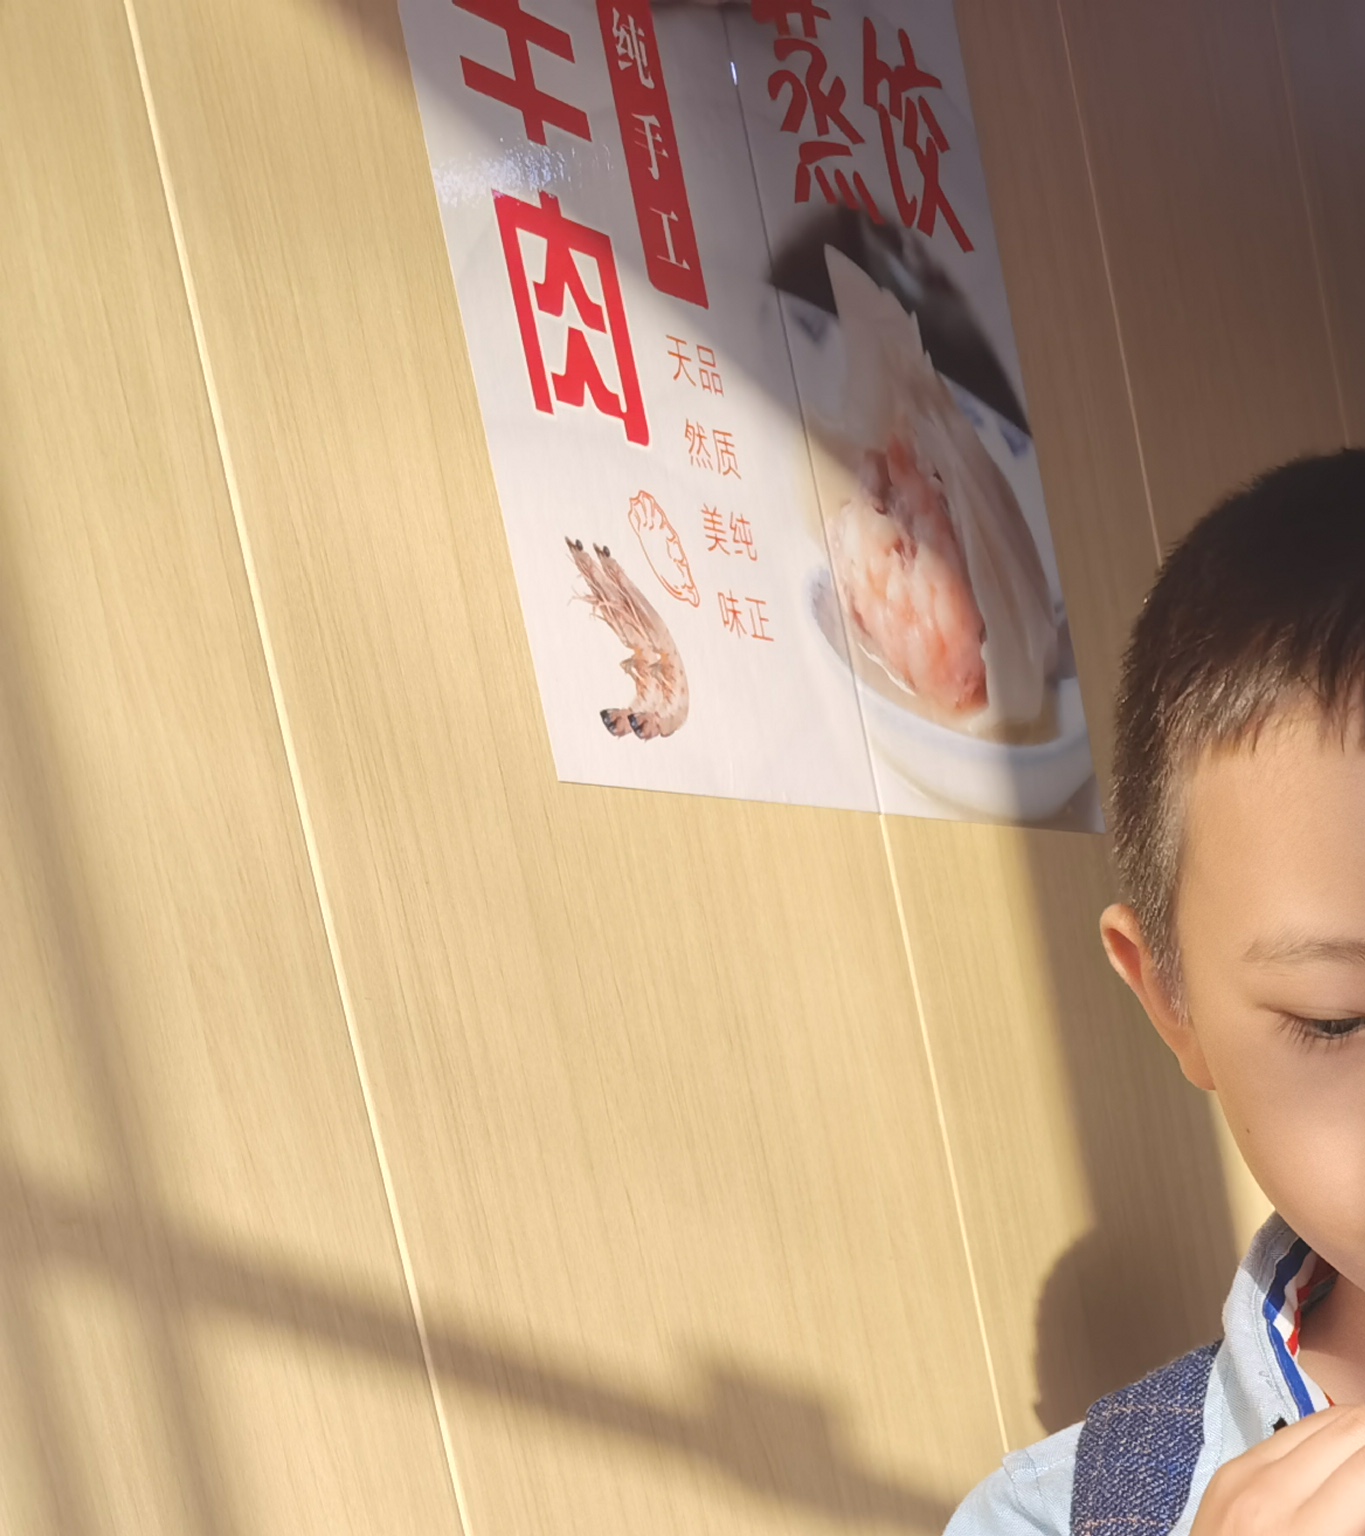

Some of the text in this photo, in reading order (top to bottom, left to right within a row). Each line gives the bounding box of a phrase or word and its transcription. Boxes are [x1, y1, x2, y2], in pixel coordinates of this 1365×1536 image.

[612, 7, 691, 271] 纯手工
[750, 0, 975, 253] 蒸饺
